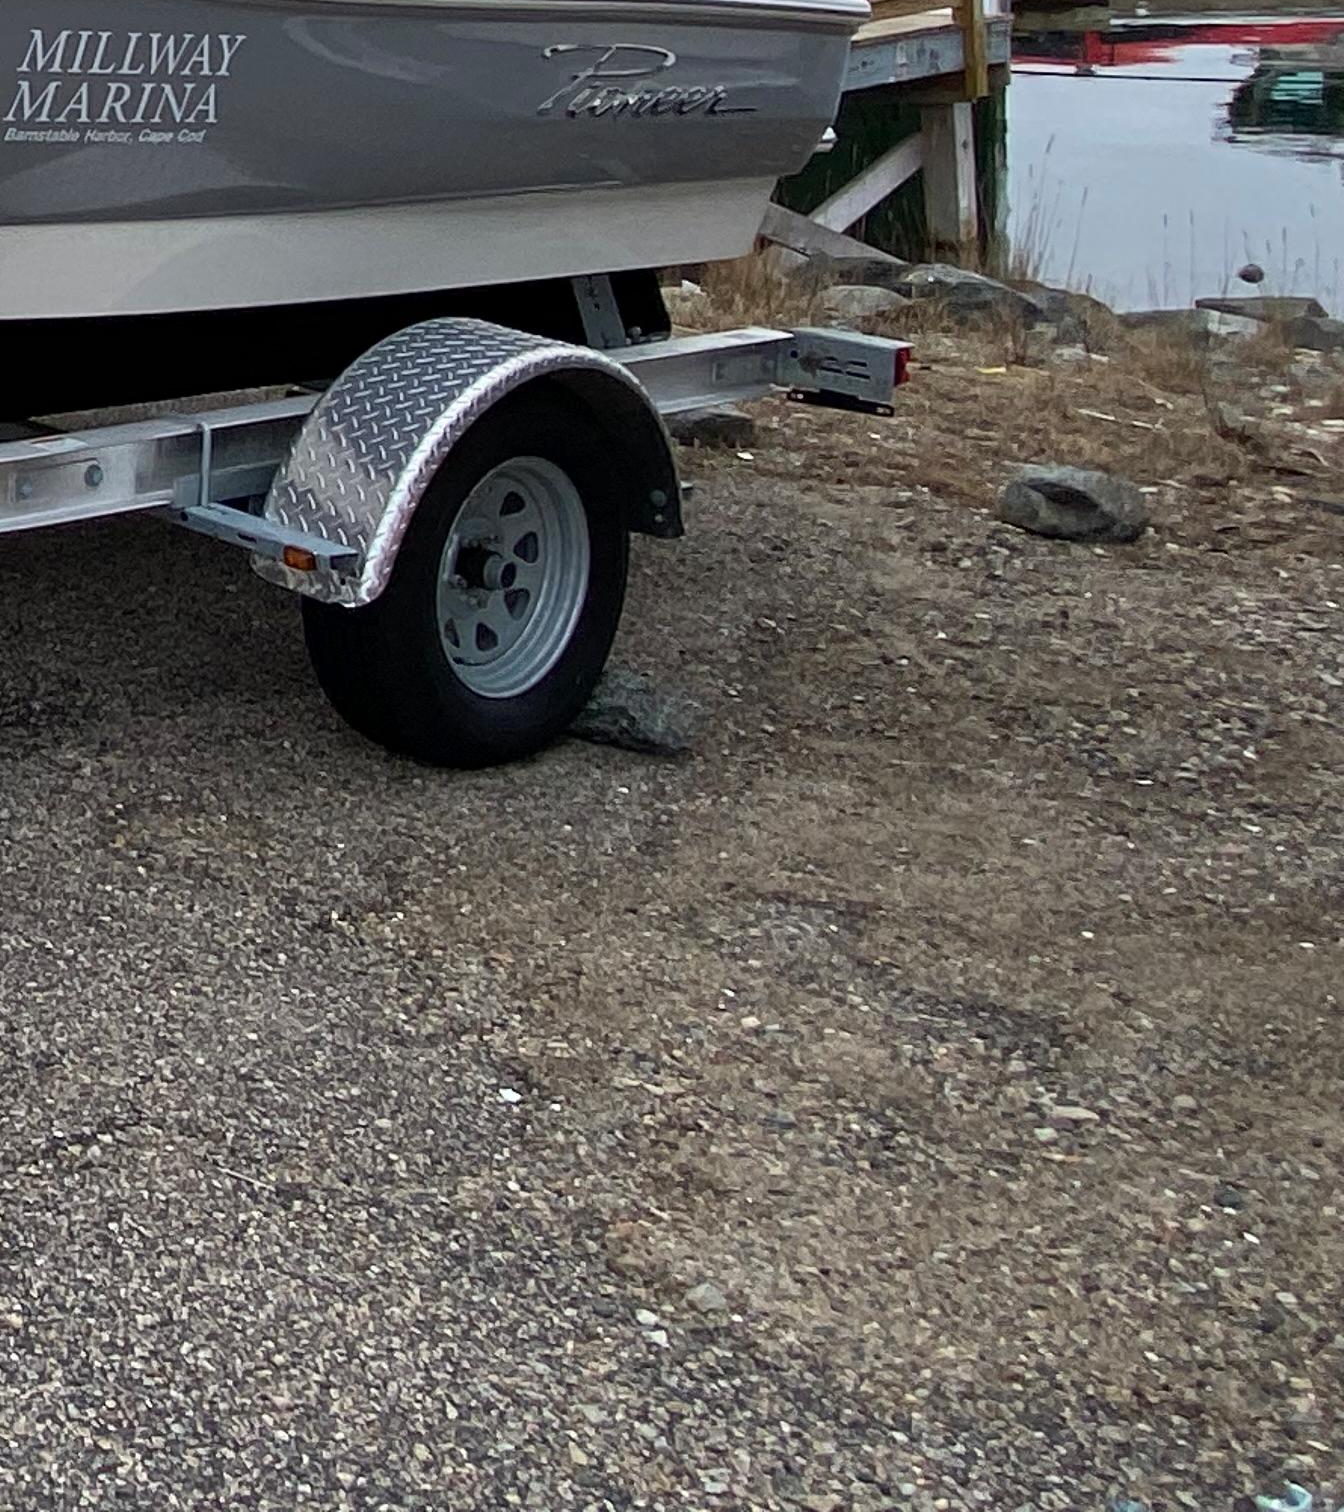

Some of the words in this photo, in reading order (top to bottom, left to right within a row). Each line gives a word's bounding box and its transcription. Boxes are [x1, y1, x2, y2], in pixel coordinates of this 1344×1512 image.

[16, 29, 248, 76] MILLWAY
[2, 80, 219, 124] MARINA
[537, 43, 758, 117] Pioneer
[3, 127, 80, 143] Barnstable
[84, 129, 133, 144] Harbor,
[138, 129, 174, 144] Cape
[177, 129, 207, 143] Cod
